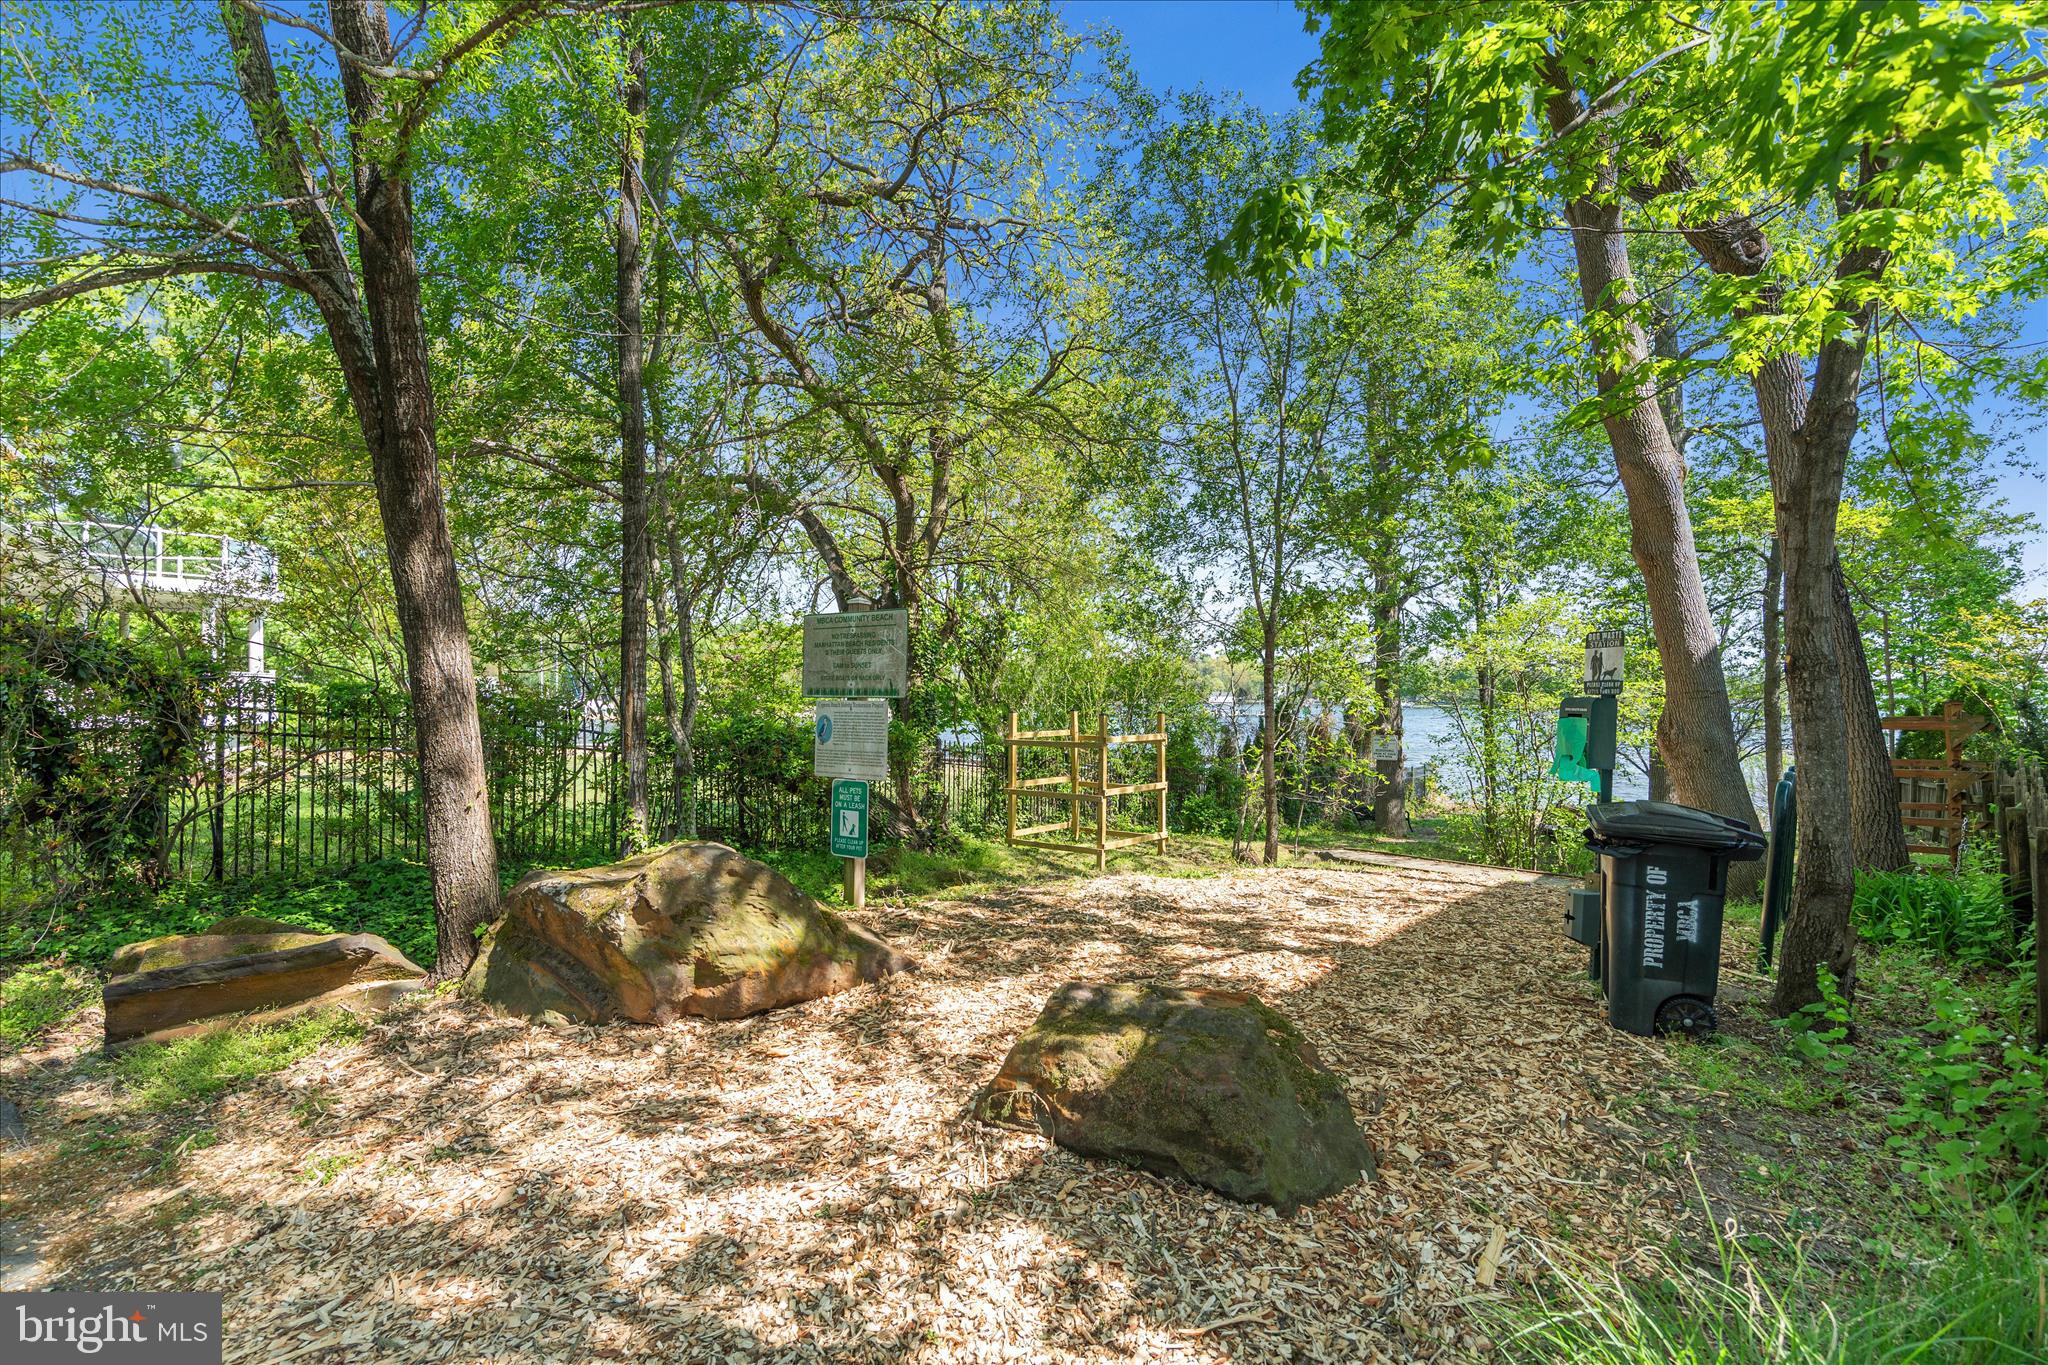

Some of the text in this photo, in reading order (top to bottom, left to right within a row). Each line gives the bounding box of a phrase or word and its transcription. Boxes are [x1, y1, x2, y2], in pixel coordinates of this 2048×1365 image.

[834, 615, 870, 624] COMMUNITY
[871, 613, 893, 621] BEACH
[840, 631, 876, 640] TRESPASSING
[1601, 630, 1622, 639] WASTE
[845, 640, 863, 648] BEACH
[864, 638, 895, 647] RESIDENTS
[1590, 640, 1620, 648] STATION
[849, 787, 862, 795] PETS
[848, 802, 865, 810] LEASH
[1643, 865, 1668, 969] PROPERTY OF
